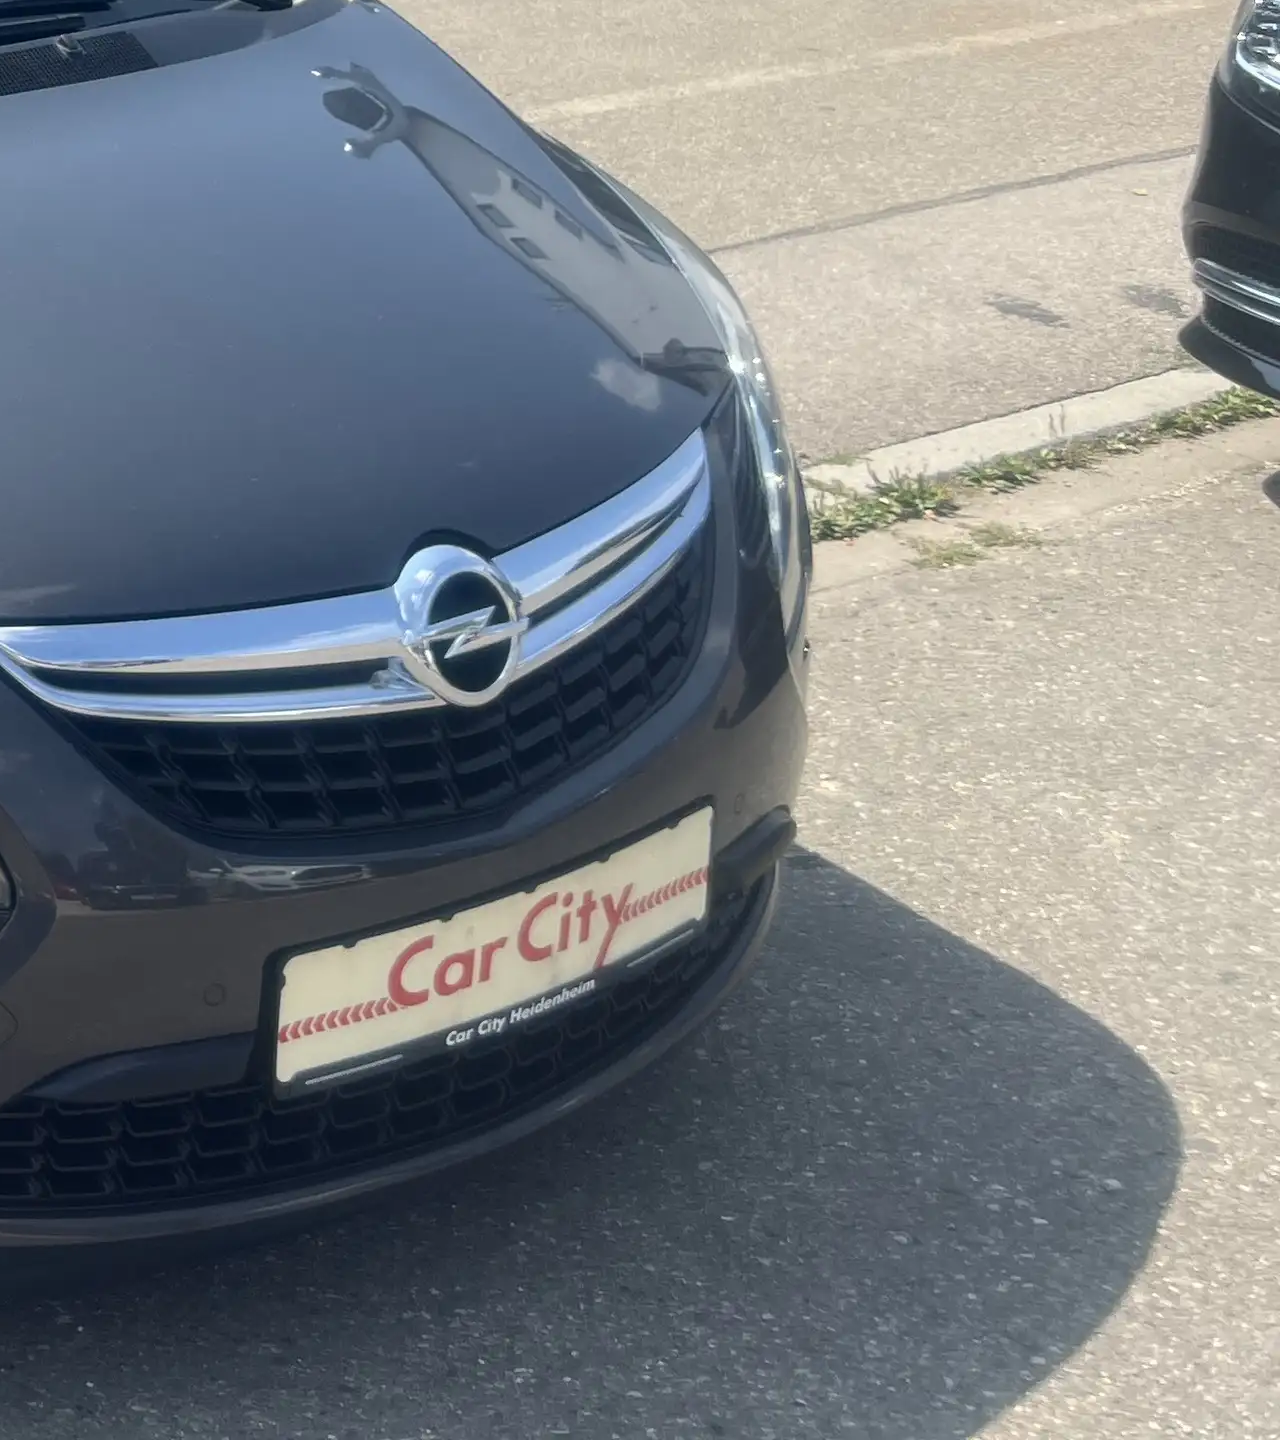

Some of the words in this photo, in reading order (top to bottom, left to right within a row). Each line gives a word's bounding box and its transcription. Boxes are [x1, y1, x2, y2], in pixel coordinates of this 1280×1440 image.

[386, 934, 509, 1007] Car
[516, 883, 635, 971] City
[444, 1028, 472, 1047] Car
[477, 1016, 507, 1039] City
[509, 977, 596, 1024] Heidenheim
